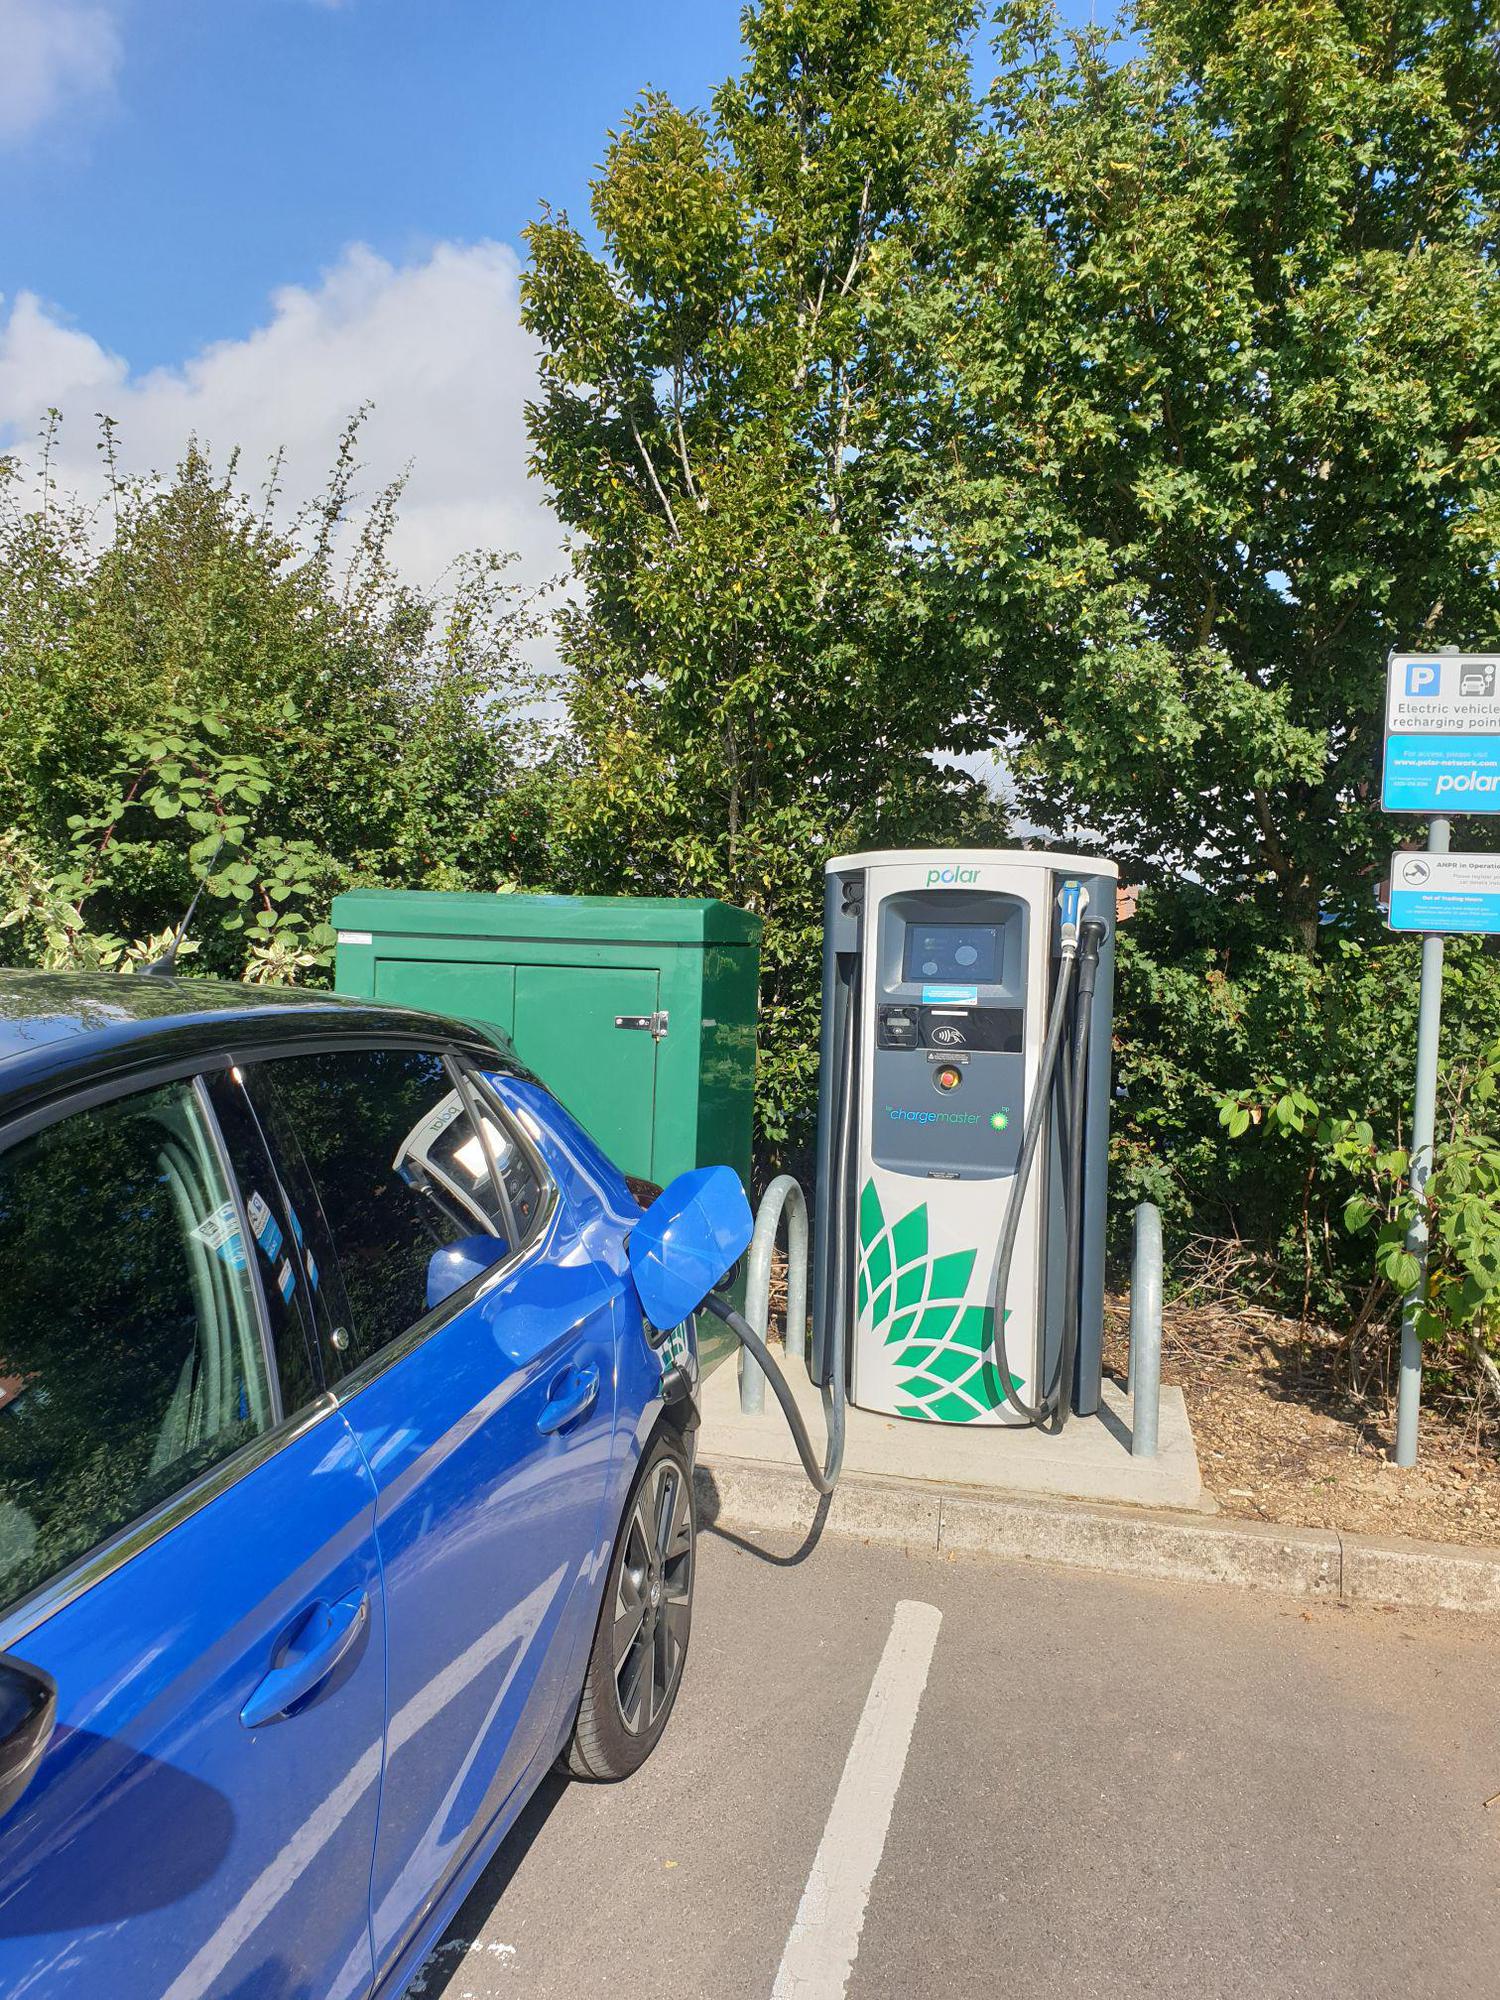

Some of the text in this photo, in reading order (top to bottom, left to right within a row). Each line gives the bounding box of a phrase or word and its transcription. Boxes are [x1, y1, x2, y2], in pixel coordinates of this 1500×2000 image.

[1411, 667, 1435, 693] P
[1398, 703, 1500, 714] Electric vehicle
[1393, 717, 1463, 728] recharging
[1435, 770, 1500, 795] polar
[926, 865, 981, 888] polar
[890, 1107, 980, 1124] chargemaster
